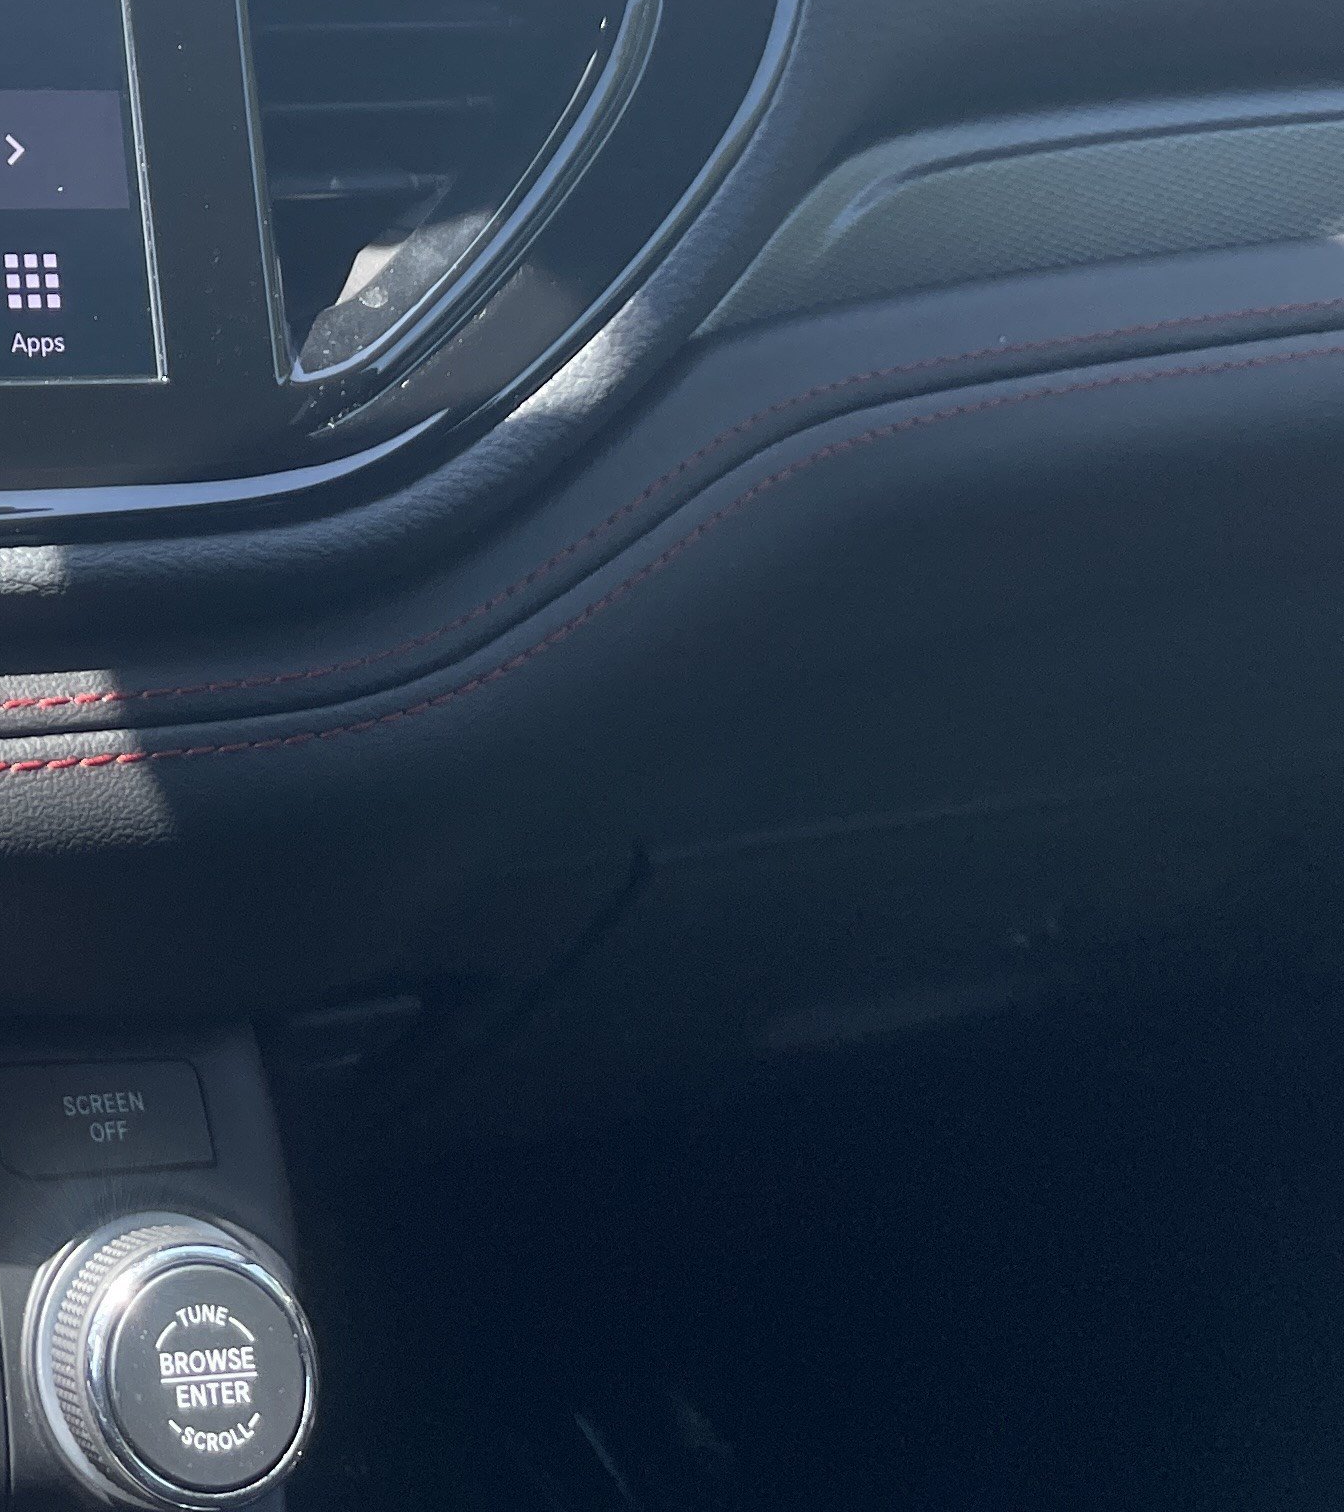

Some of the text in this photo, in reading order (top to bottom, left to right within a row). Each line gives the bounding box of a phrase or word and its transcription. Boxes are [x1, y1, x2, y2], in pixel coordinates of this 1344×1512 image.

[9, 332, 67, 362] Apps
[62, 1090, 146, 1118] SCREEN
[89, 1118, 130, 1144] OFF
[174, 1303, 230, 1330] TUNE
[158, 1346, 256, 1376] BROWSE
[174, 1380, 251, 1410] ENTER
[180, 1420, 256, 1454] SCROLL
